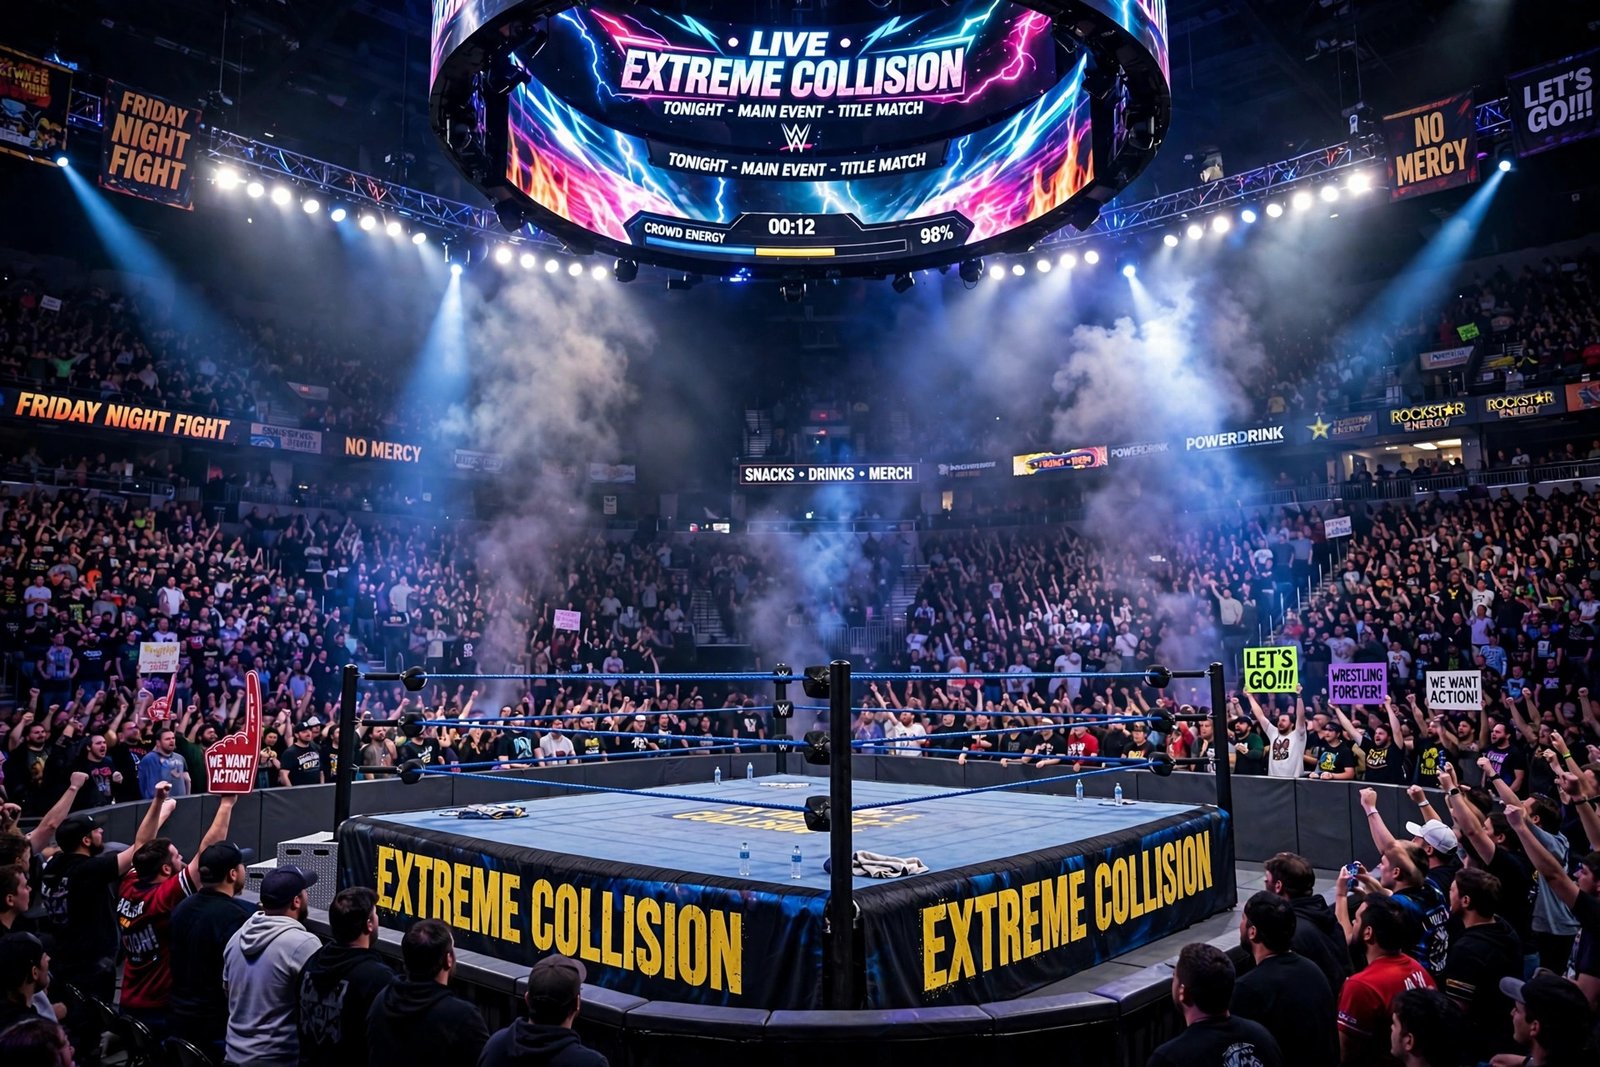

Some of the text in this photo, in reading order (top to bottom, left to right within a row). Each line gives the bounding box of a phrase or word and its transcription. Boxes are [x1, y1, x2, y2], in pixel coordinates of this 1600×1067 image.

[749, 31, 829, 57] LIVE
[620, 47, 966, 98] EXTREME COLLISION
[1523, 66, 1593, 110] LET'S
[121, 91, 189, 129] FRIDAY
[663, 101, 726, 118] TONIGHT
[737, 103, 776, 118] MAIN
[778, 104, 825, 119] EVENT
[838, 102, 874, 118] TITLE
[878, 100, 924, 117] MATCH
[1528, 90, 1594, 133] GO!!!
[112, 113, 191, 159] NIGHT
[1413, 111, 1444, 148] NO
[108, 145, 187, 191] FIGHT
[668, 152, 729, 174] TONIGHT
[741, 161, 779, 178] MAIN
[782, 163, 827, 178] EVENT
[840, 158, 875, 176] TITLE
[878, 152, 926, 173] MATCH
[1395, 138, 1468, 187] MERCY
[644, 222, 726, 245] CROWD ENERGY
[768, 218, 816, 236] 00:12
[920, 224, 954, 244] 98%
[15, 391, 102, 424] FRIDAY
[104, 404, 171, 433] NIGHT
[173, 414, 231, 441] FIGHT
[345, 436, 367, 457] NO
[371, 440, 422, 463] MERCY
[1186, 427, 1285, 450] POWERDRINK
[744, 466, 913, 482] SNACKS DRINKS MERCH
[1246, 649, 1293, 669] LET'S
[1249, 669, 1295, 692] GO!!!
[1331, 667, 1384, 684] WRESTLING
[1430, 675, 1479, 690] WE WANT
[1332, 684, 1382, 702] FOREVER!
[1430, 690, 1479, 705] ACTION!
[209, 754, 253, 769] WE WANT
[212, 769, 250, 784] ACTION!
[375, 843, 743, 996] EXTREME COLLISION
[921, 830, 1213, 992] EXTREME COLLISION
